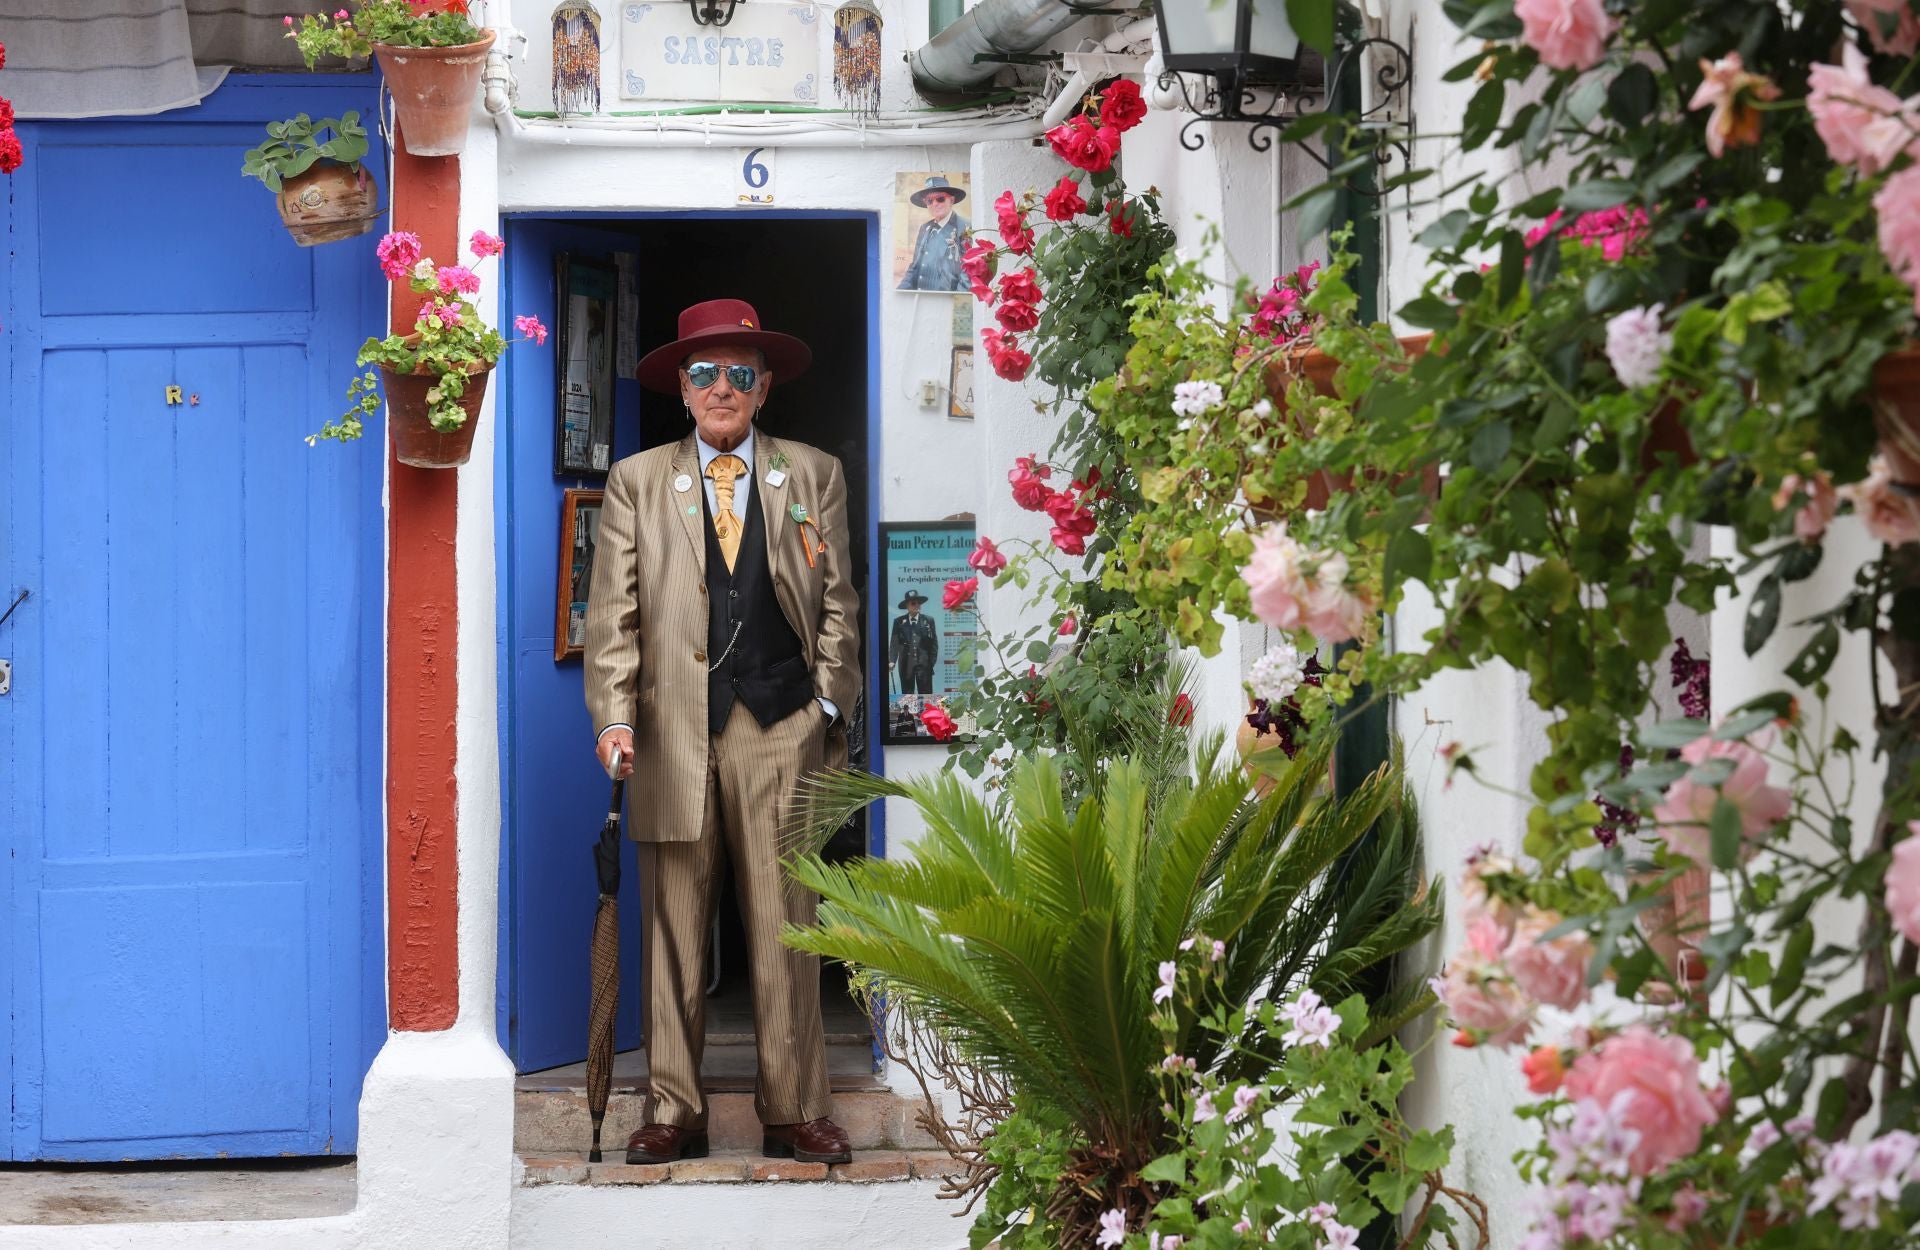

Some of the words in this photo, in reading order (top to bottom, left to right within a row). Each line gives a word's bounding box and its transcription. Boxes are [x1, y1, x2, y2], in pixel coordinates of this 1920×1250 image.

[663, 35, 784, 68] SASTRE
[743, 147, 769, 189] 6
[165, 385, 183, 405] R
[914, 535, 945, 549] Pérez
[913, 565, 942, 573] reciben
[907, 575, 941, 585] despiden
